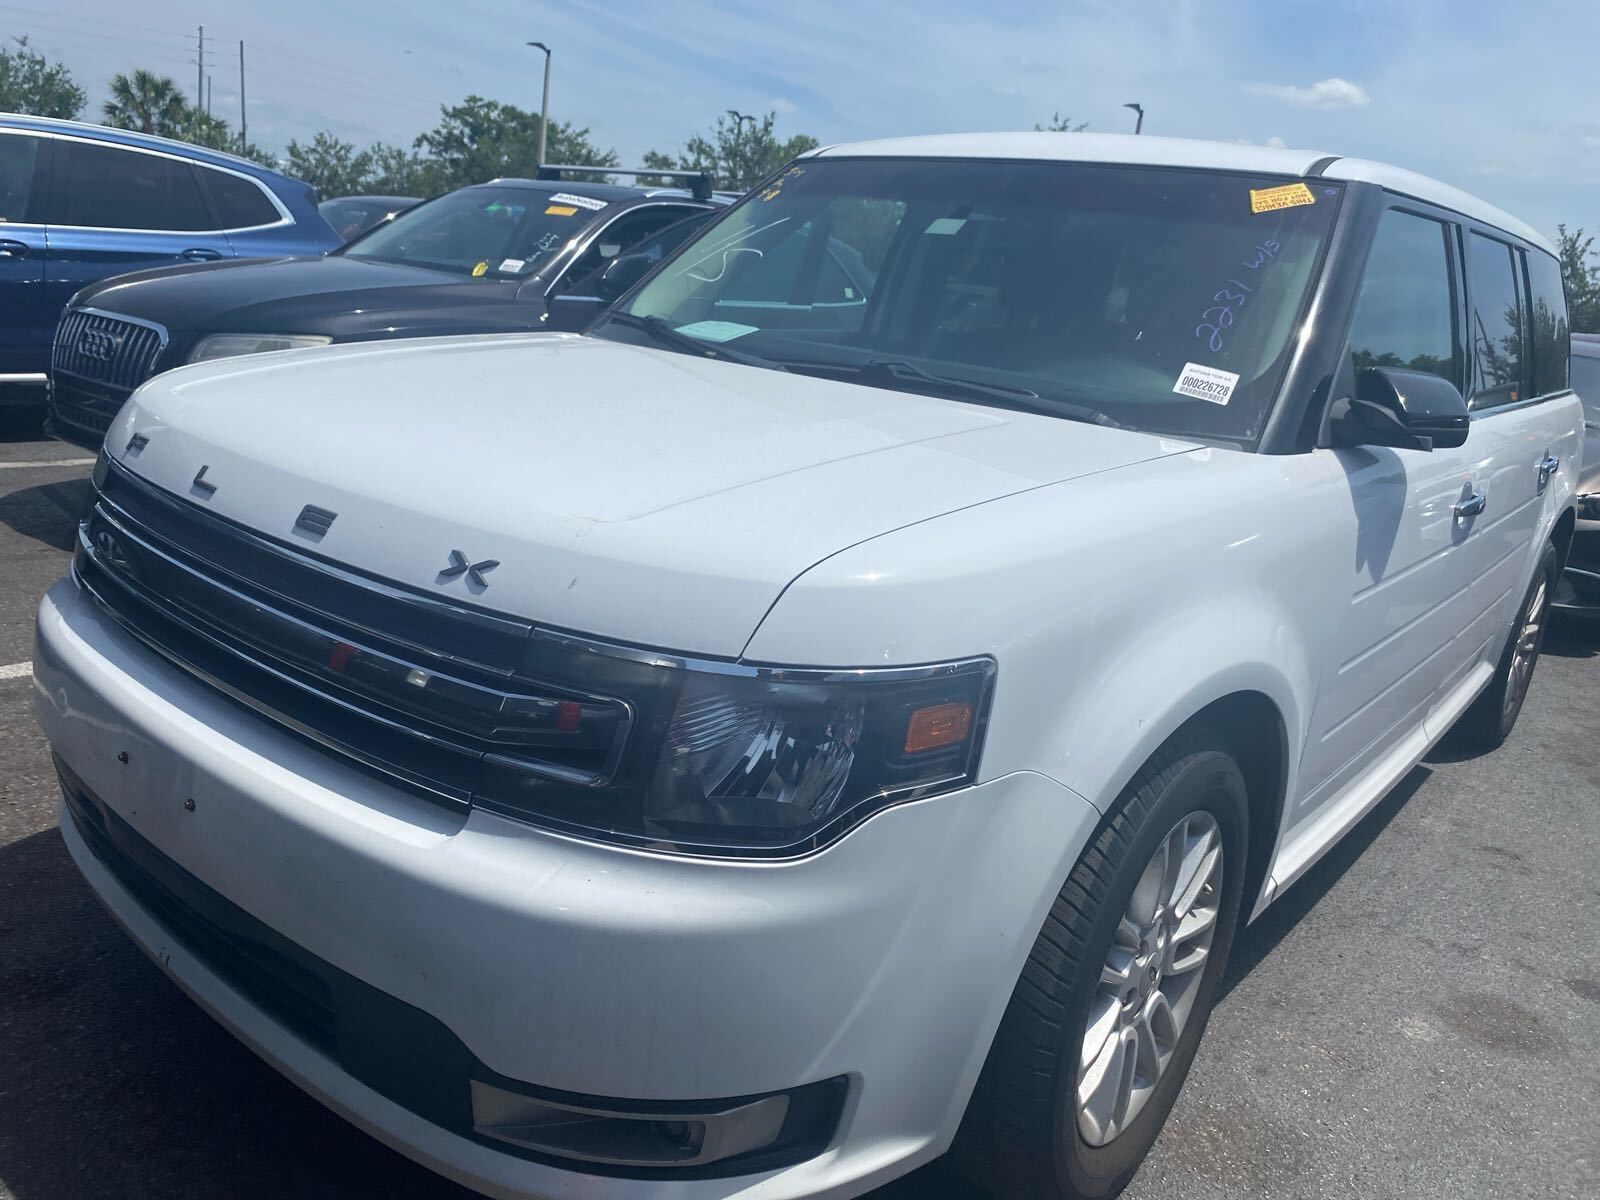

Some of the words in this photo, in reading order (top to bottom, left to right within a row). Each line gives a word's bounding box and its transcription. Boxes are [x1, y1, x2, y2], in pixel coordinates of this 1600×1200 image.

[1290, 193, 1307, 201] NOT
[1290, 197, 1313, 206] THIS
[1255, 201, 1289, 212] VEHICL
[1195, 279, 1253, 352] 2231
[1181, 375, 1231, 397] 000226728
[125, 432, 501, 588] FLEX
